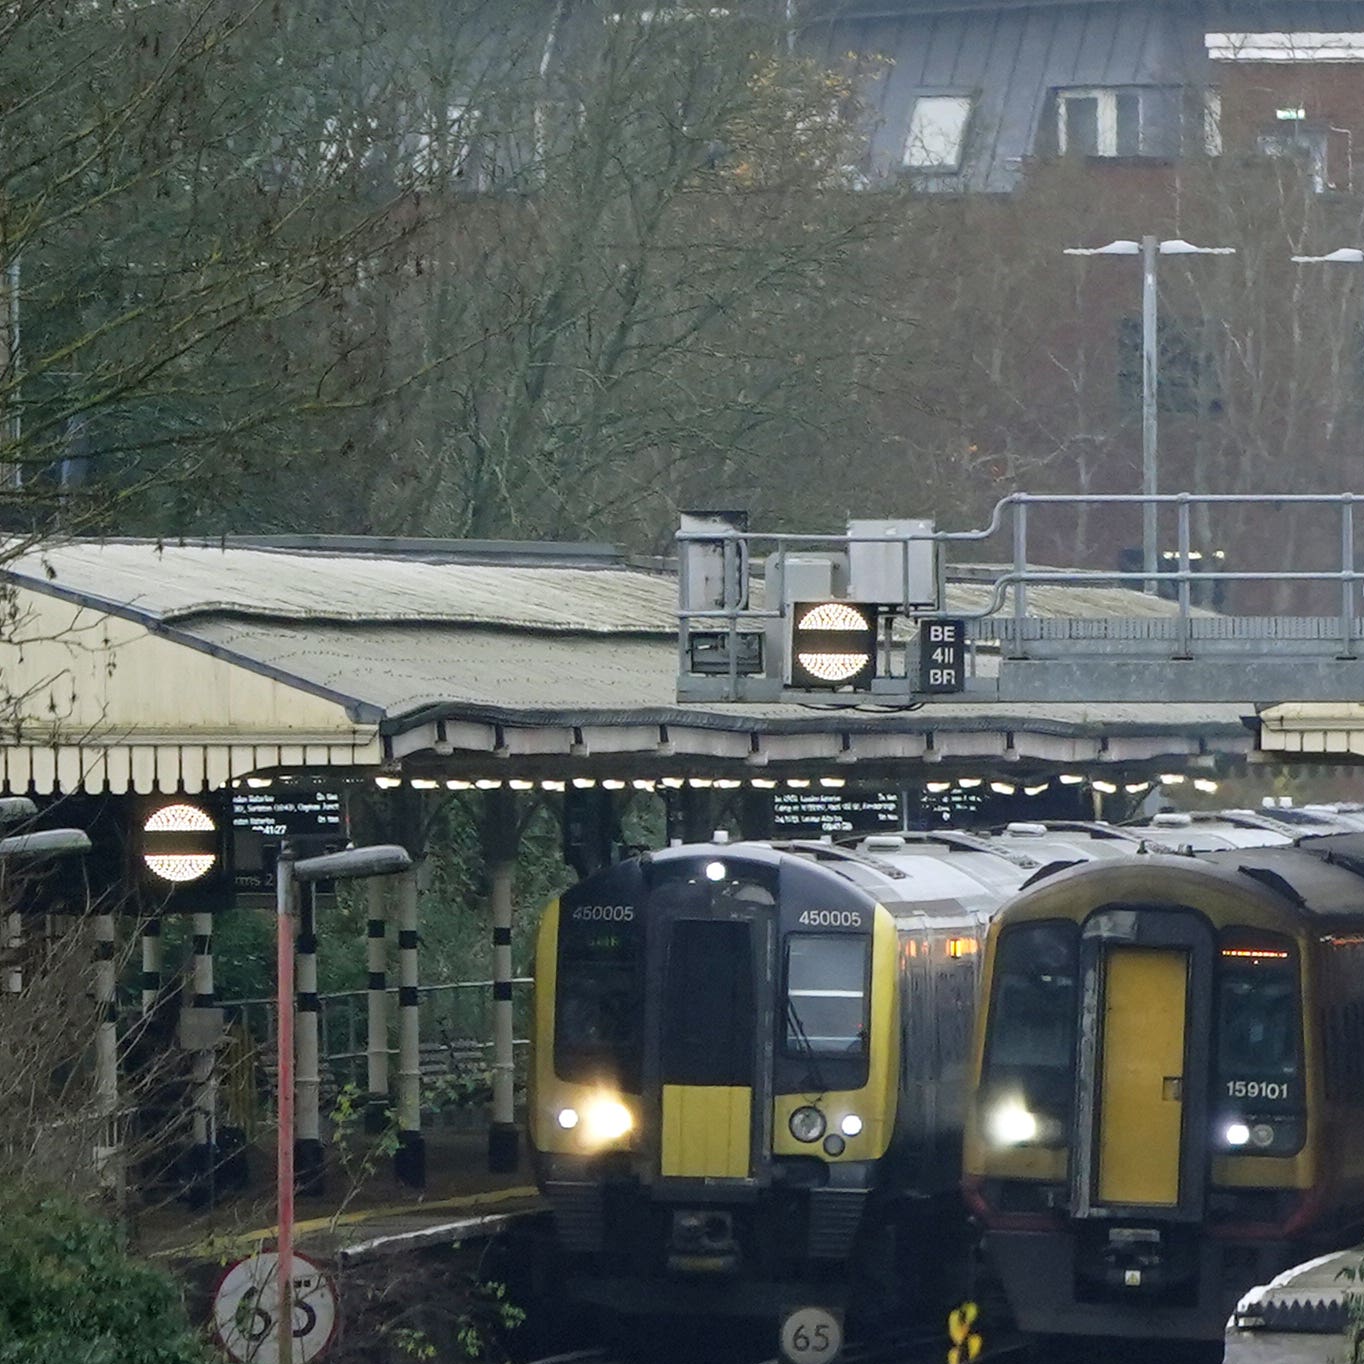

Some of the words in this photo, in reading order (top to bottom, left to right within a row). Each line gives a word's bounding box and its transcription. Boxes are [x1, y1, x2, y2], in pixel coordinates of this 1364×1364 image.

[930, 626, 955, 641] BE
[932, 647, 954, 664] 411
[572, 906, 634, 921] 450005
[799, 910, 861, 927] 450005
[1226, 1081, 1288, 1099] 159101
[793, 1325, 829, 1352] 65
